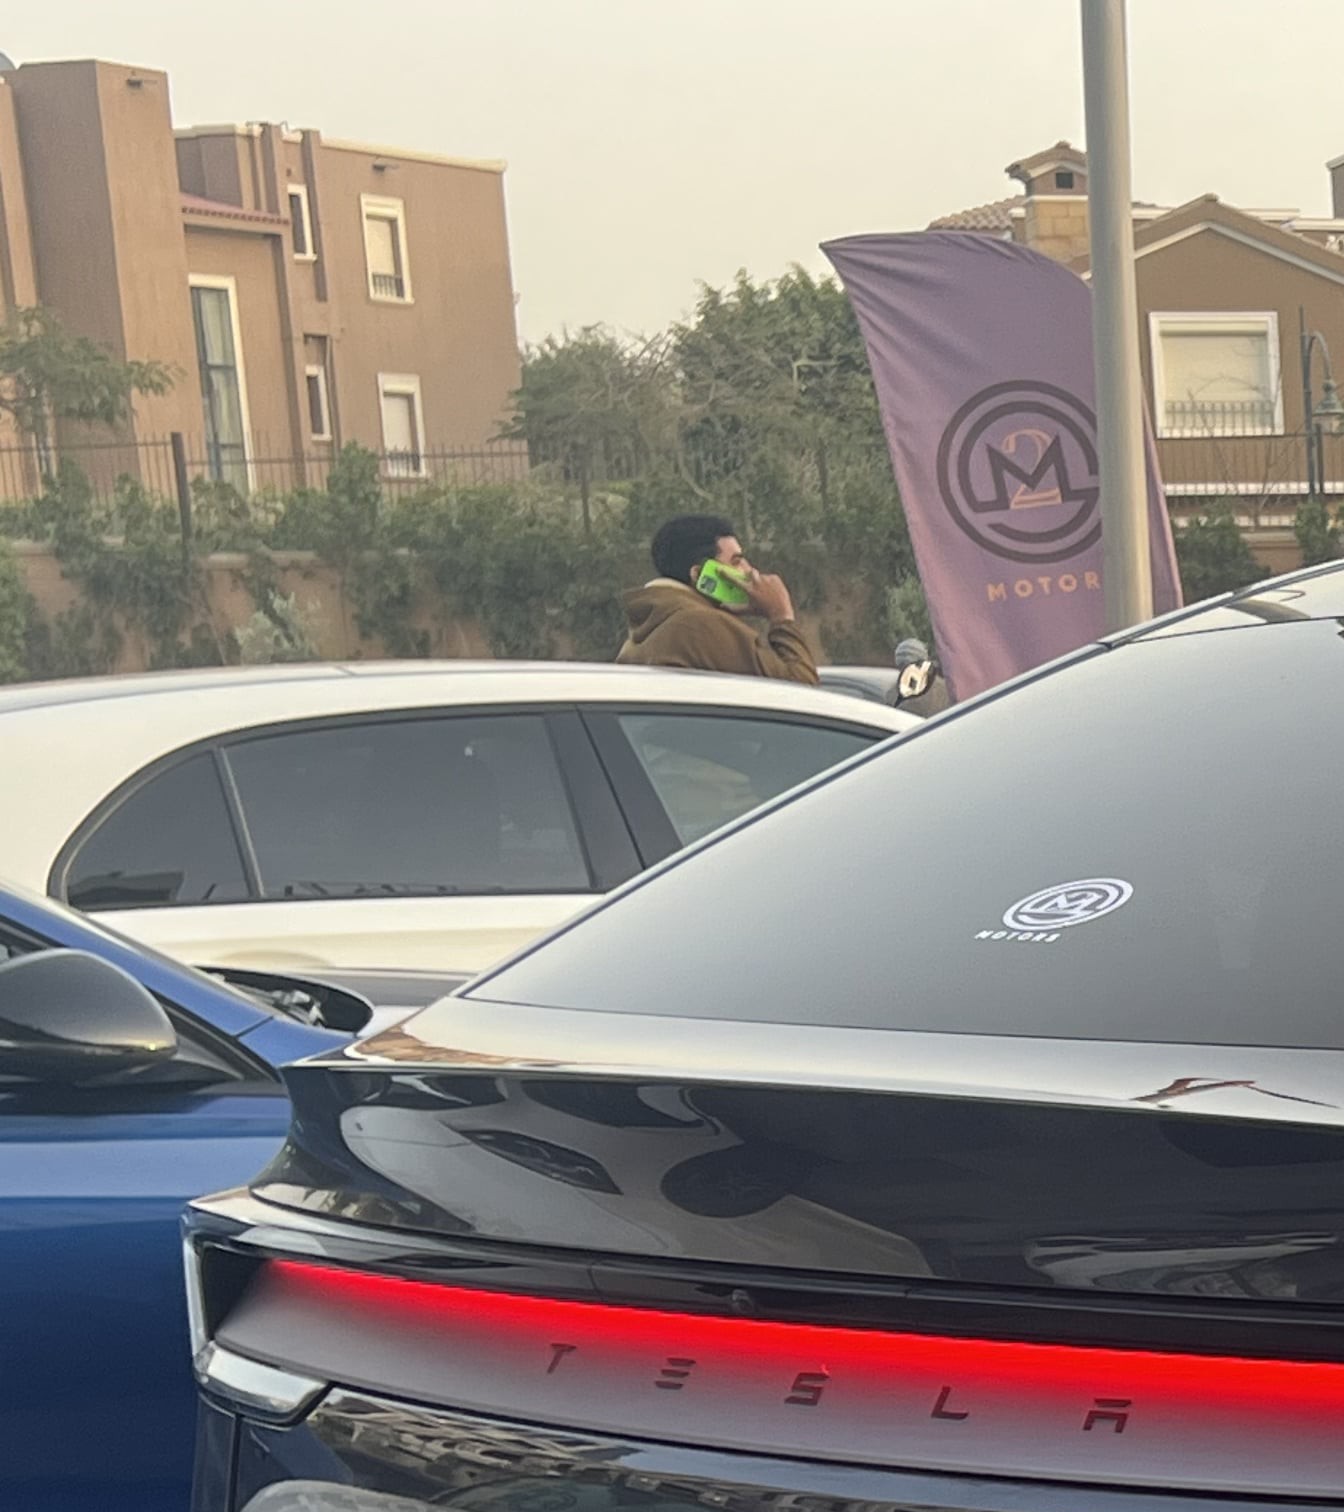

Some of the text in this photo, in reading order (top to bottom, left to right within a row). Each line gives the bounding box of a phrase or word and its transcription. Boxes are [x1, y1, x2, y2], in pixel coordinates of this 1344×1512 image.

[987, 571, 1100, 602] MOTOR
[974, 930, 1060, 942] MOTORS
[546, 1343, 1132, 1434] TESLA
